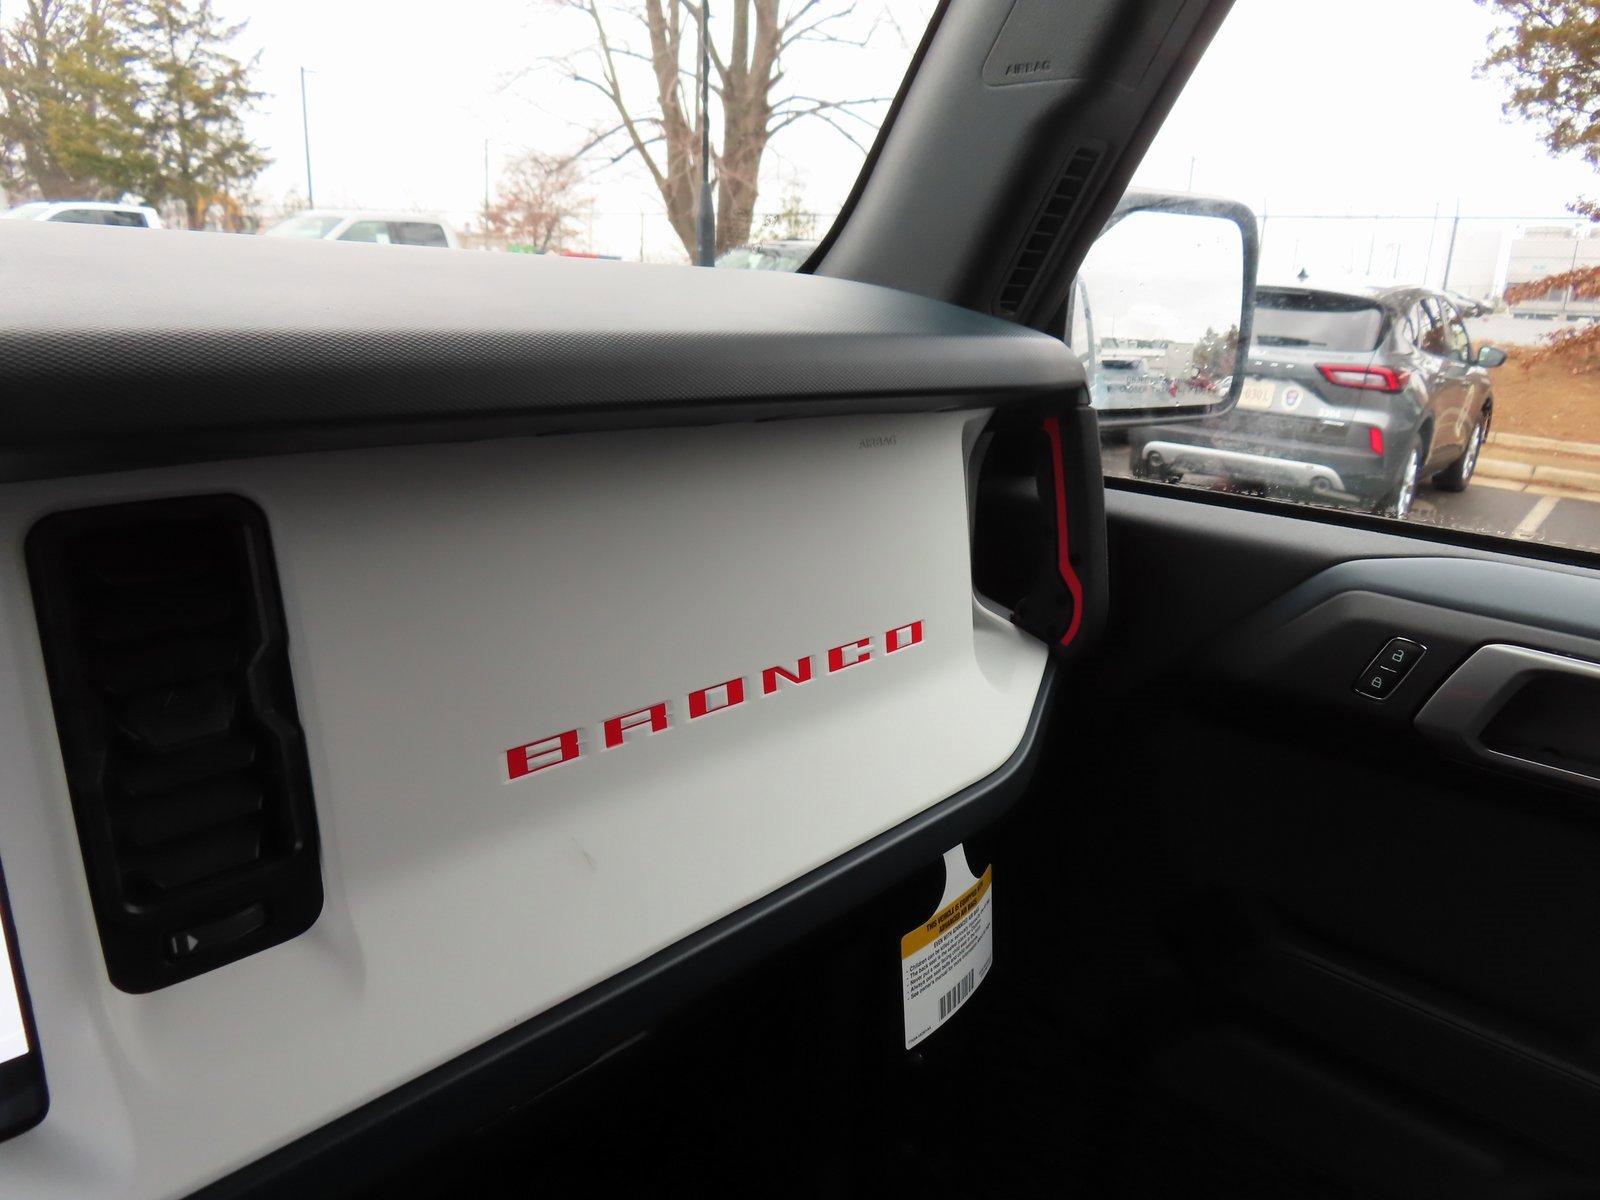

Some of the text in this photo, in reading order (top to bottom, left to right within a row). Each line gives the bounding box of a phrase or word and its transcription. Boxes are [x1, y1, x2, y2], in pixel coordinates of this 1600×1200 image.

[503, 619, 925, 783] BRONCO
[933, 936, 943, 949] EVEN
[909, 957, 926, 972] Children
[909, 969, 918, 978] The
[918, 963, 928, 973] back
[909, 973, 922, 985] Never
[910, 978, 925, 992] Always
[910, 989, 919, 999] See
[919, 979, 934, 993] owner's
